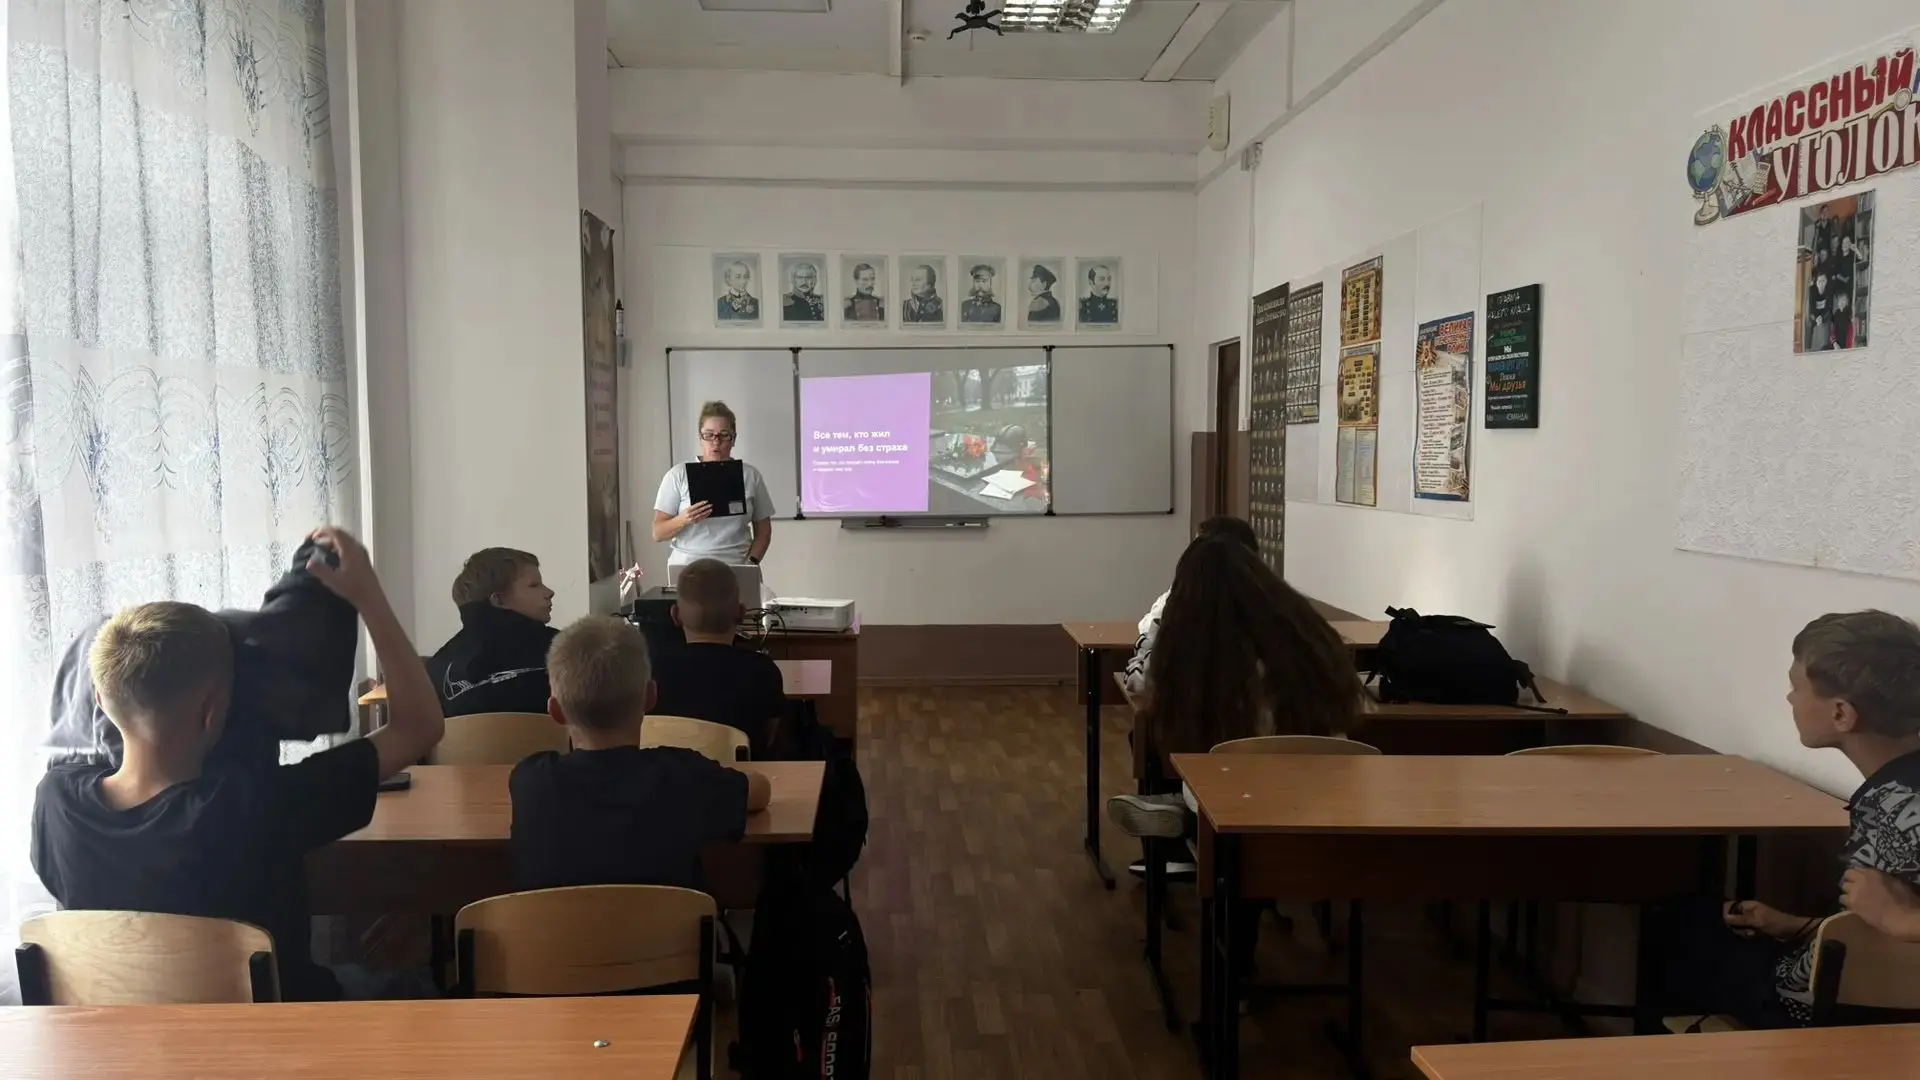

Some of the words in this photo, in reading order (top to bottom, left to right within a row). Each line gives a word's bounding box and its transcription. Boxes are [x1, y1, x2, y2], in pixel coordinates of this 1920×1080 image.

[1728, 47, 1915, 162] КЛАССНЫЙ
[821, 446, 856, 455] умирал
[858, 444, 874, 452] без
[875, 443, 909, 454] страха
